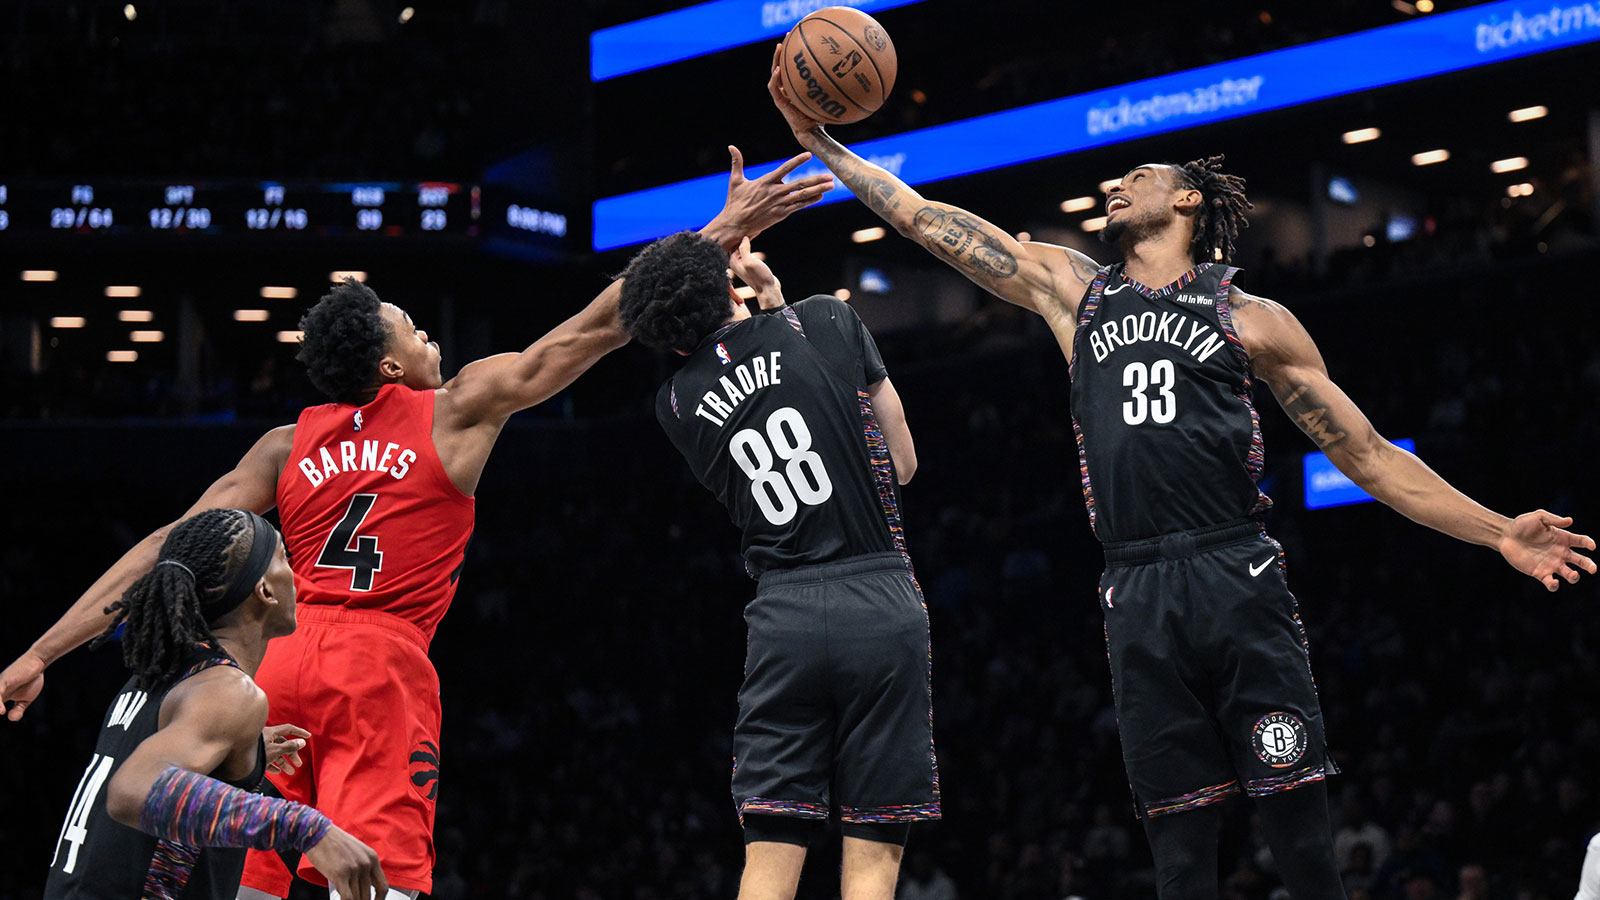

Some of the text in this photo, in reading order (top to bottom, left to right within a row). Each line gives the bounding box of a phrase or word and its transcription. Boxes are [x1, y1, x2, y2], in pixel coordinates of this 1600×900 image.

[793, 50, 847, 119] Wilson
[1087, 76, 1265, 136] ticketmaster
[1176, 294, 1213, 306] All In Won
[1089, 311, 1226, 363] BROOKLYN
[695, 351, 781, 427] TRAORE
[1122, 359, 1177, 425] 33
[1284, 385, 1310, 407] I
[1296, 407, 1346, 449] AM
[298, 440, 417, 488] BARNES
[729, 407, 833, 526] 88
[314, 493, 383, 592] 4
[1256, 715, 1300, 735] BROOKLYN
[1273, 727, 1286, 752] B
[1261, 747, 1301, 763] NEW YORK
[50, 753, 114, 874] 14
